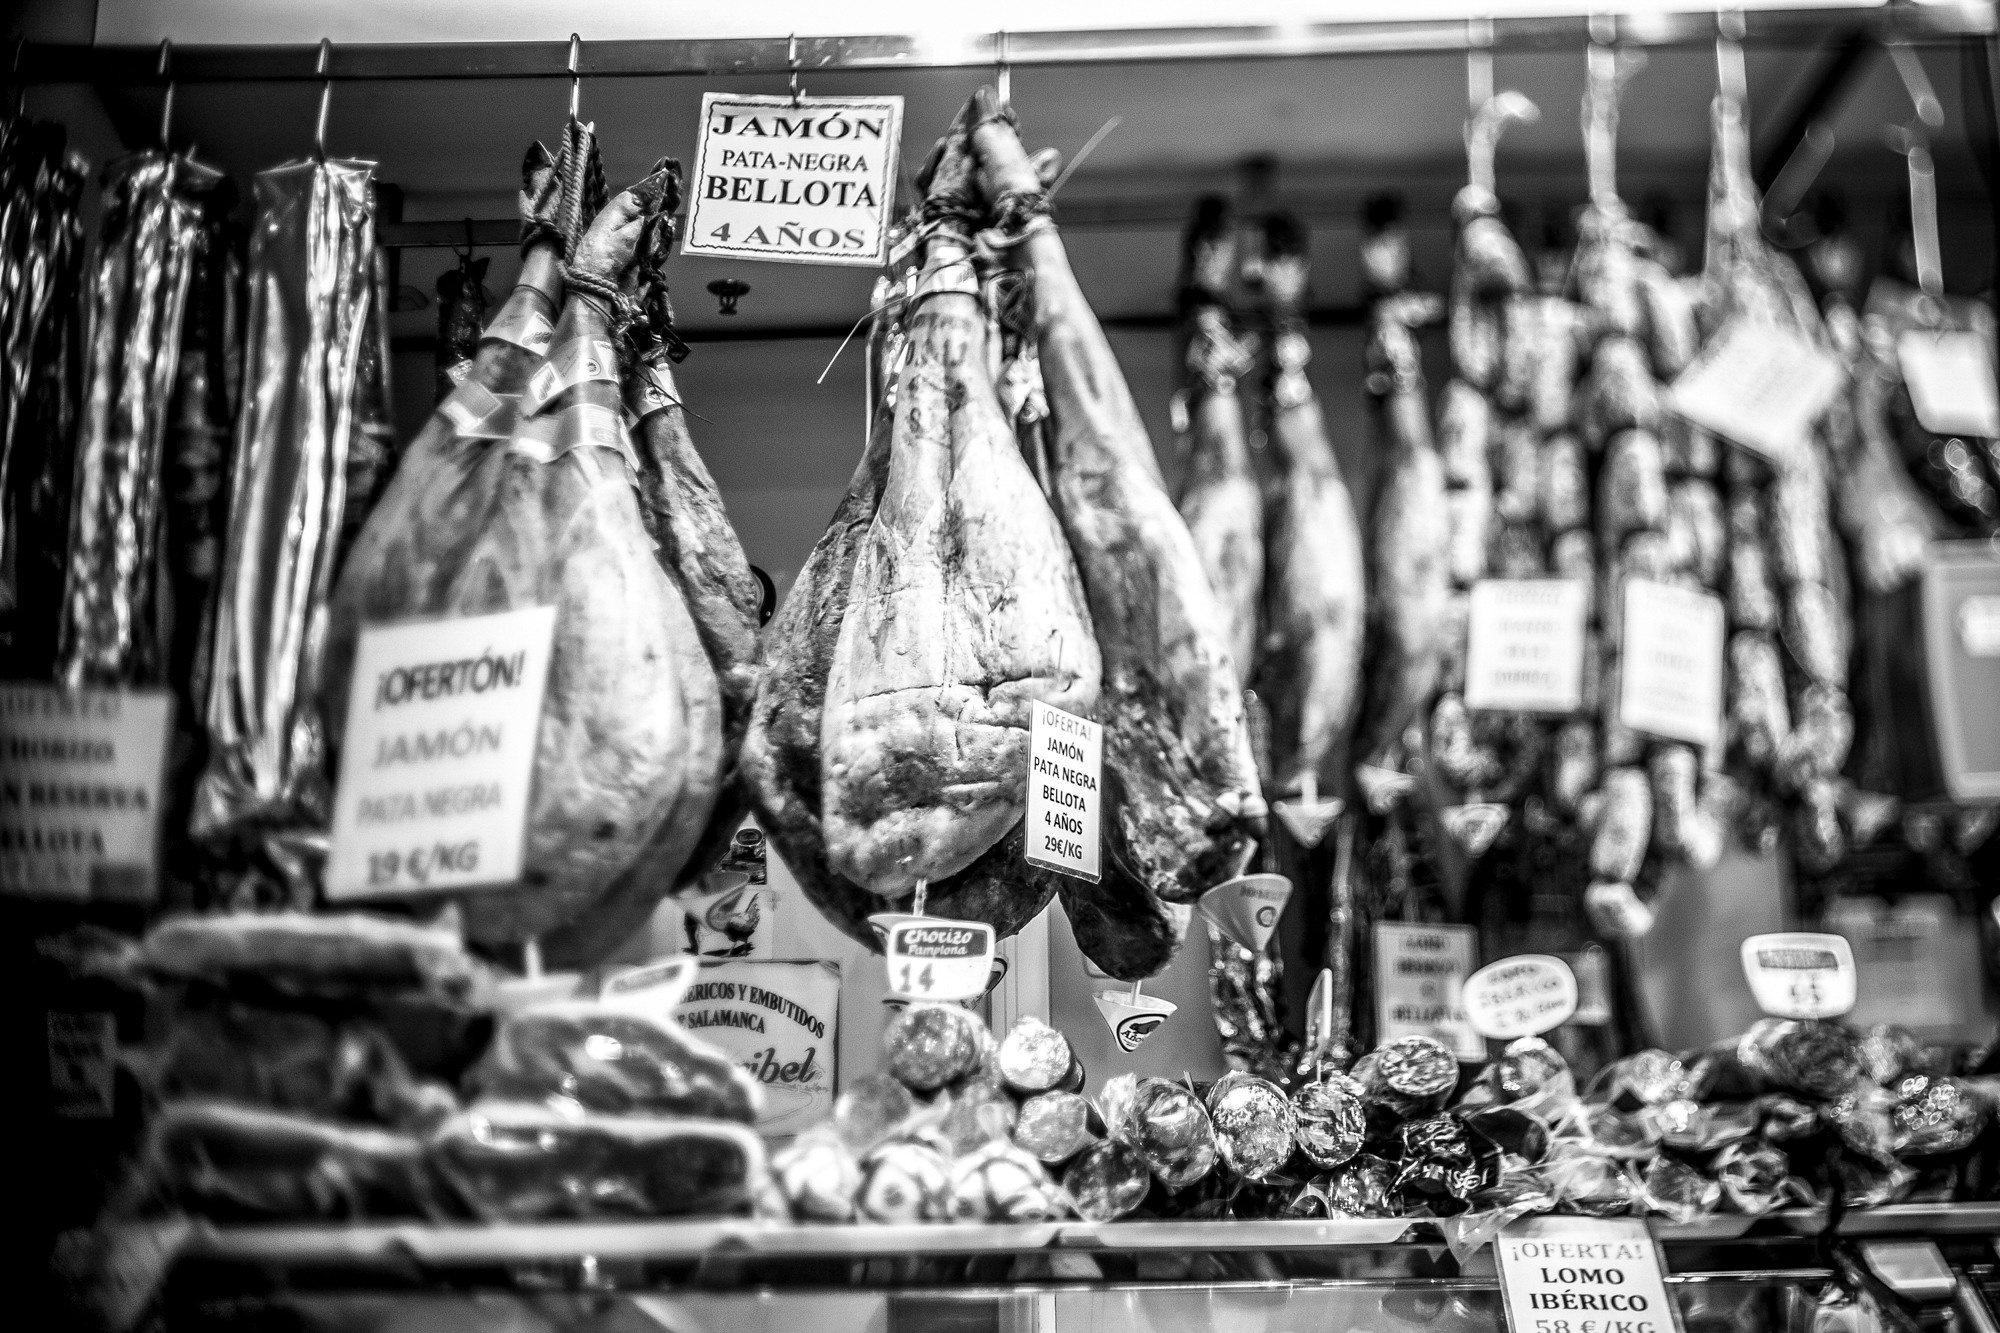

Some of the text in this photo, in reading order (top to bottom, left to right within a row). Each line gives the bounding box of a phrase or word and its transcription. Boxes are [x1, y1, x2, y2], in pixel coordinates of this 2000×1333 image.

[712, 112, 885, 139] JAMÓN
[721, 150, 869, 172] PATA-NEGRA
[704, 175, 877, 208] BELLOTA
[710, 221, 865, 249] 4 AÑOS
[374, 648, 525, 711] ¡OFERTÓN!
[1042, 709, 1092, 741] ¡OFERTA!
[372, 720, 502, 769] JAMÓN
[1047, 737, 1084, 763] JAMÓN
[1034, 756, 1097, 791] PATA NEGRA
[1043, 784, 1086, 812] BELLOTA
[1044, 811, 1083, 835] 4 AÑOS
[1044, 835, 1082, 860] 29€/KG
[904, 928, 973, 945] Chorizo
[908, 944, 968, 958] Pamplona
[681, 982, 825, 1039] ERICOS Y EMBUTIDOS
[688, 1010, 765, 1034] SALAMANCA
[1512, 1243, 1644, 1261] ¡OFERTA!
[1541, 1268, 1625, 1285] LOMO
[1529, 1289, 1648, 1312] IBÉRICO
[1536, 1320, 1570, 1333] 58
[1606, 1320, 1656, 1333] /KG
